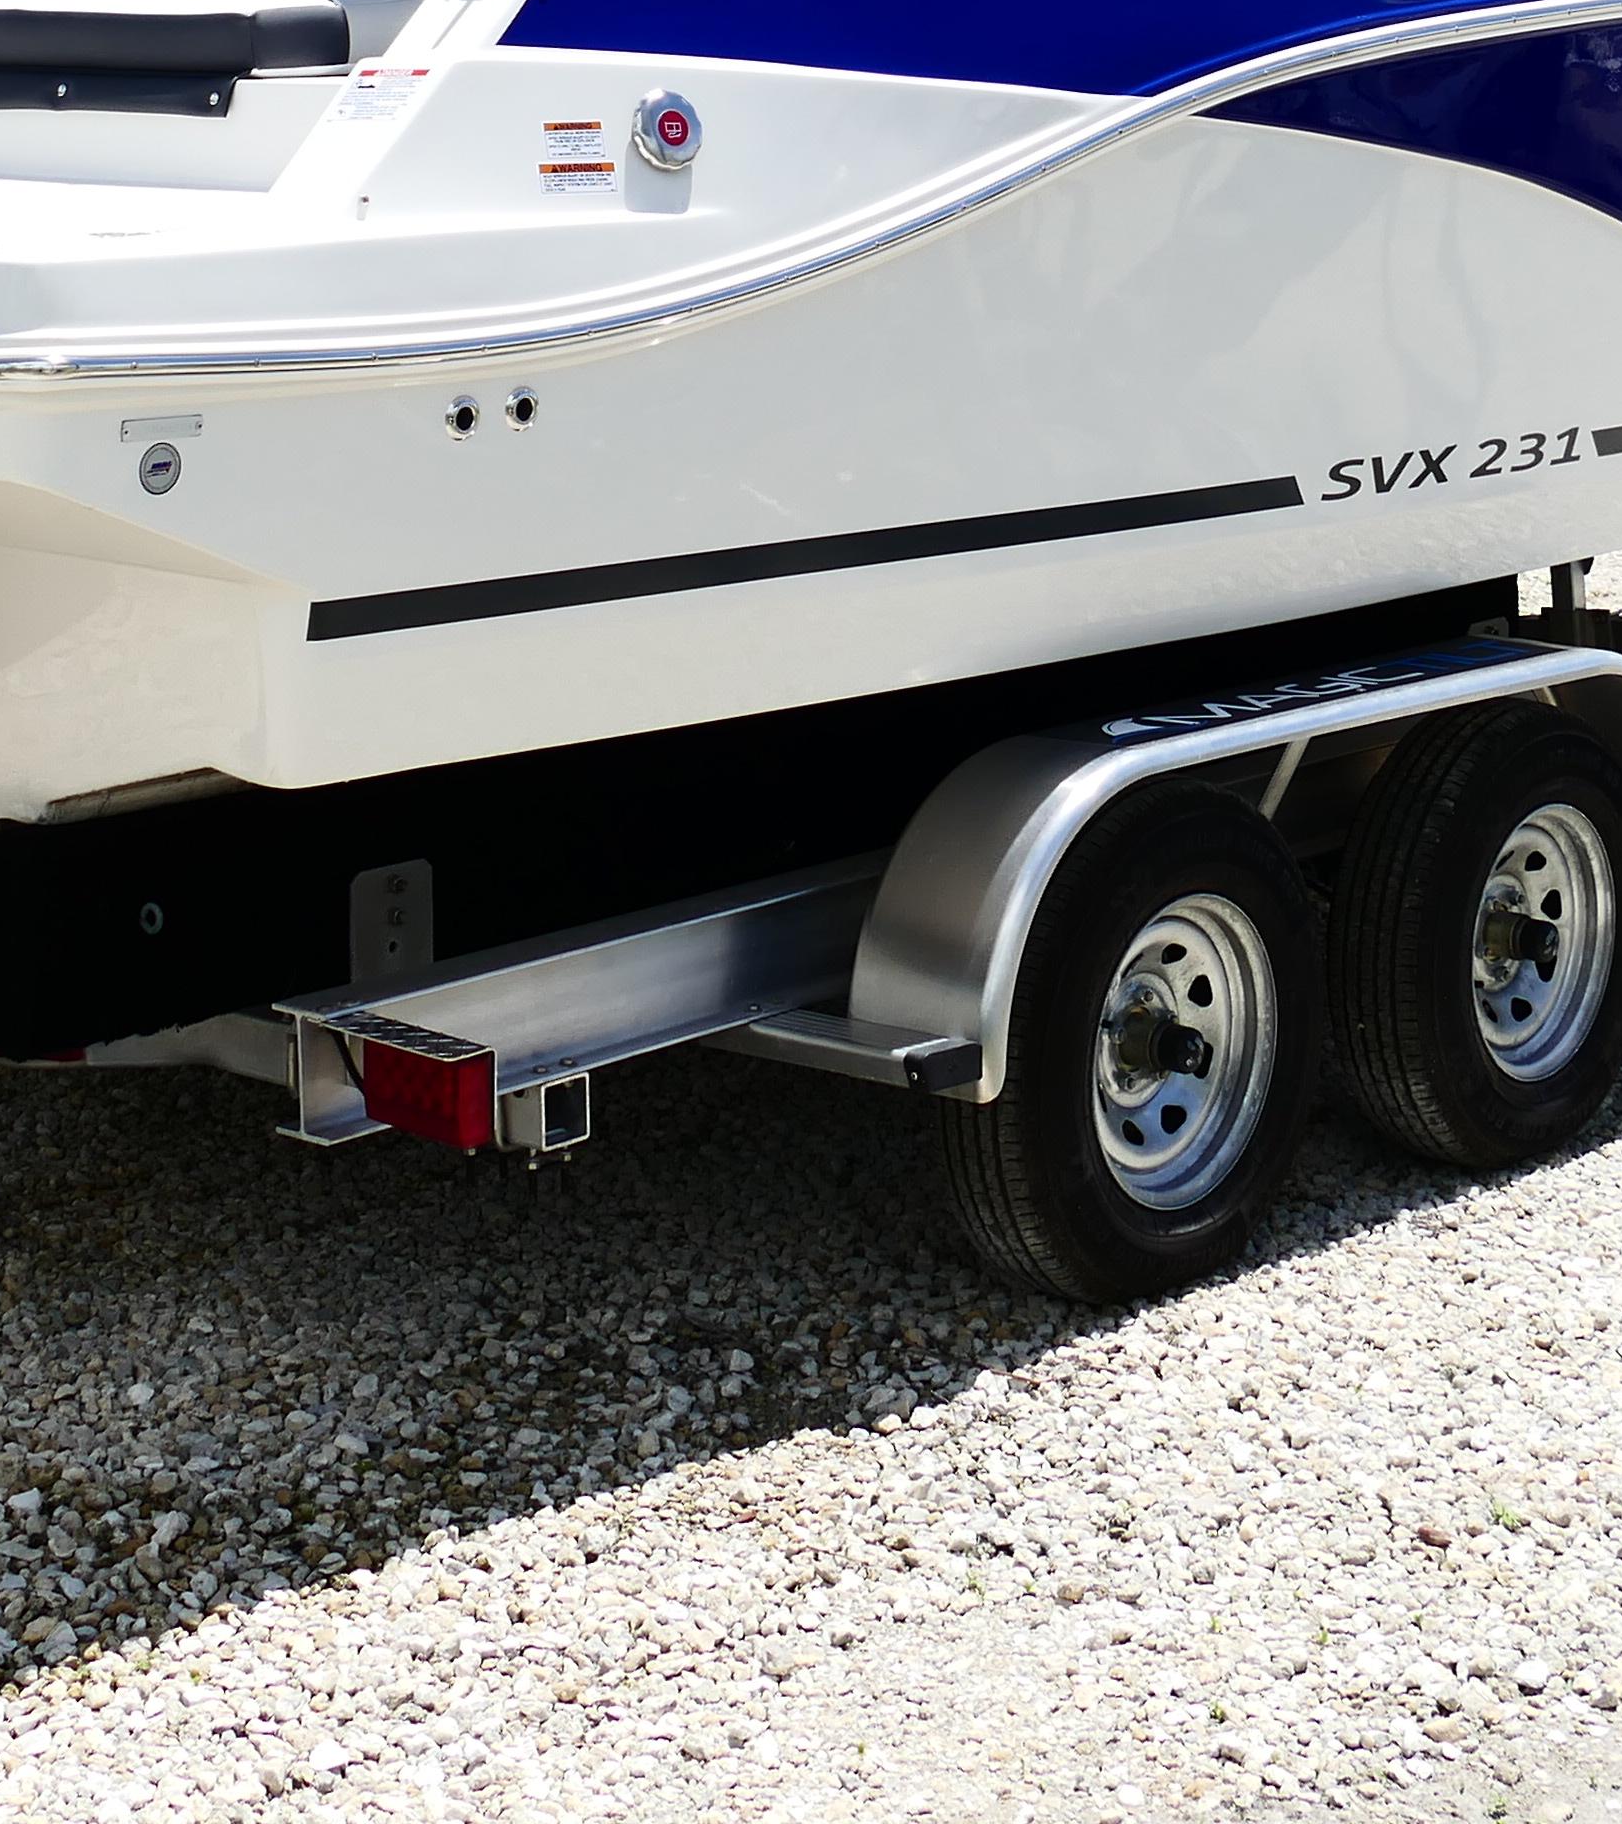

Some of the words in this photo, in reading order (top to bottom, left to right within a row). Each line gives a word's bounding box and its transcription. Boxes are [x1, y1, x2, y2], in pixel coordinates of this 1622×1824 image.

[558, 163, 603, 172] WARNING
[1320, 444, 1458, 501] SVX
[1469, 426, 1582, 479] 231
[1141, 641, 1532, 727] MAGICTILT
